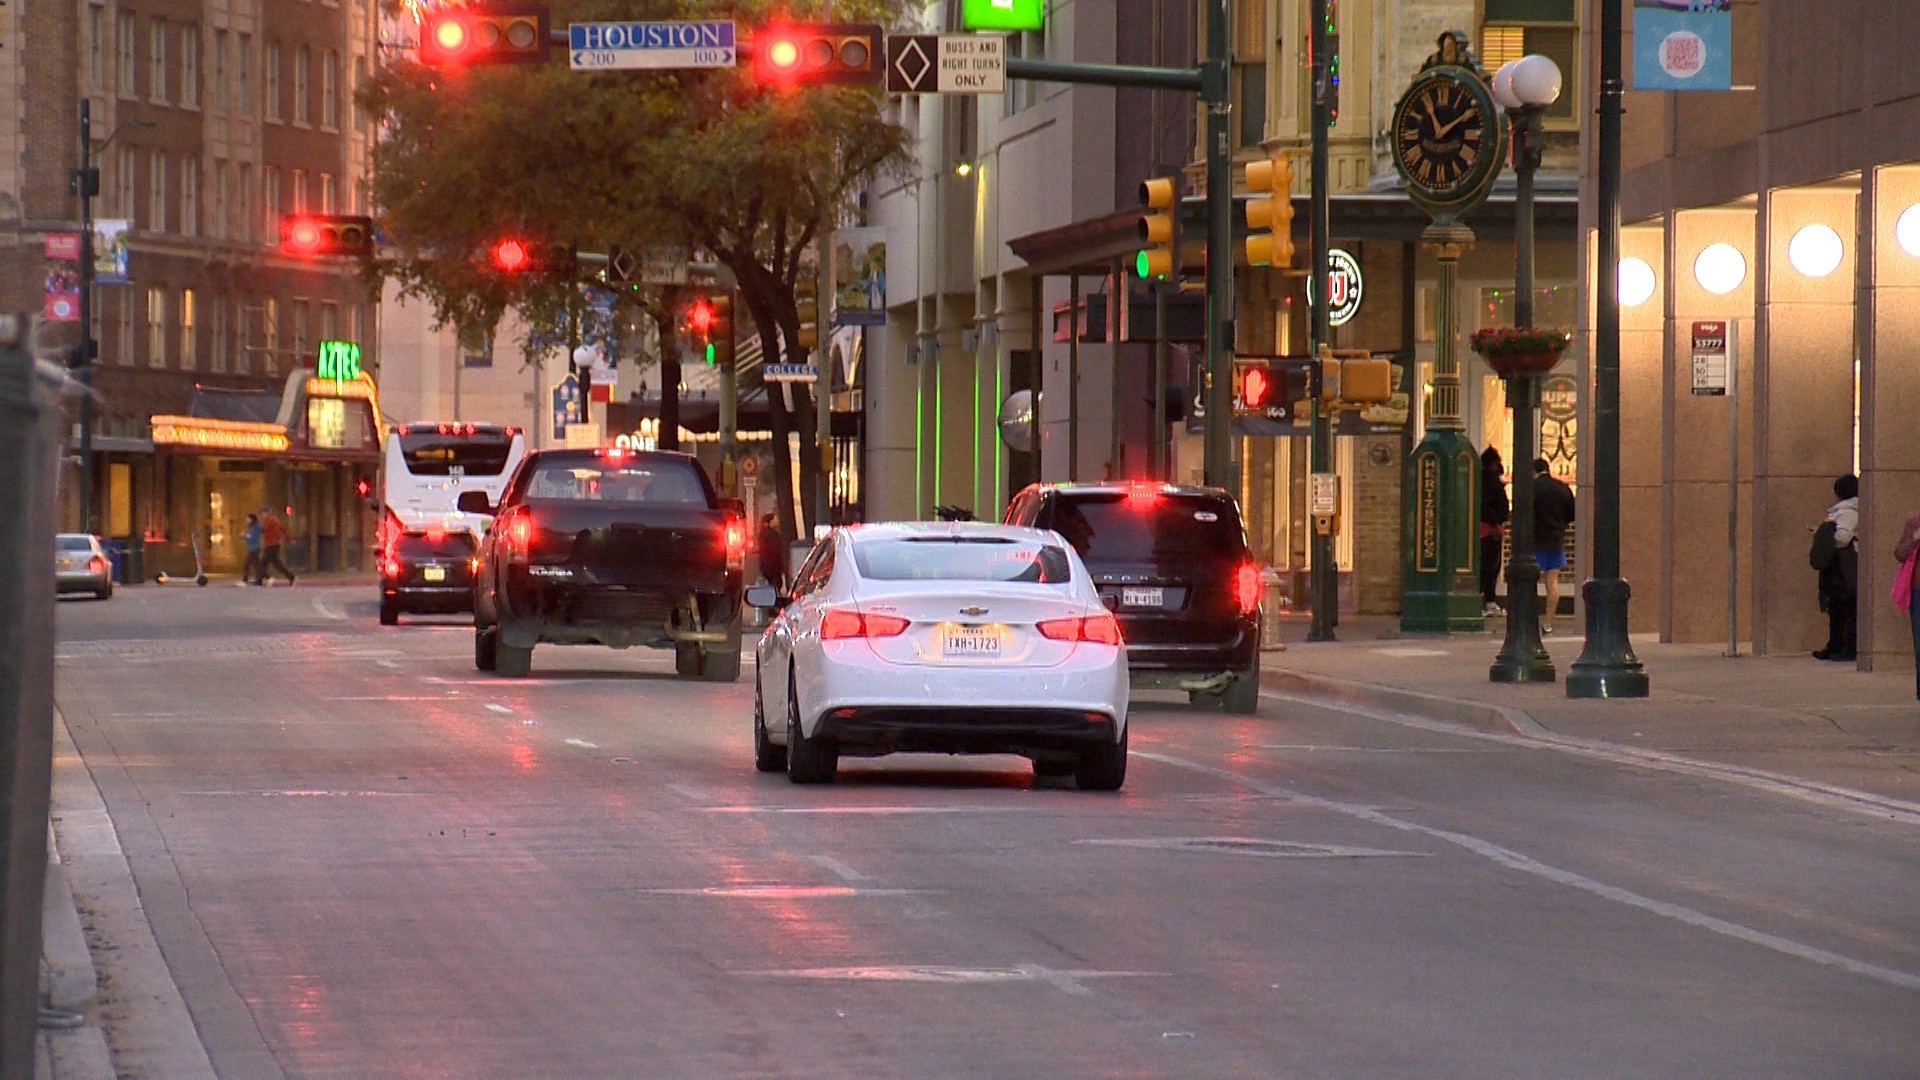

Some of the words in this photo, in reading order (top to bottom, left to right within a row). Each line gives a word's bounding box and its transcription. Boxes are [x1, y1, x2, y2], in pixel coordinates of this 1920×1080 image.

[584, 25, 719, 48] HOUSTON
[946, 42, 974, 53] BUSES
[980, 42, 997, 53] AND
[589, 53, 615, 65] 200
[693, 51, 717, 64] 100
[942, 58, 967, 69] RIGHT
[973, 58, 1000, 69] TURNS
[955, 76, 986, 86] ONLY
[318, 341, 361, 395] AZTEC
[766, 364, 818, 376] COLLEGE
